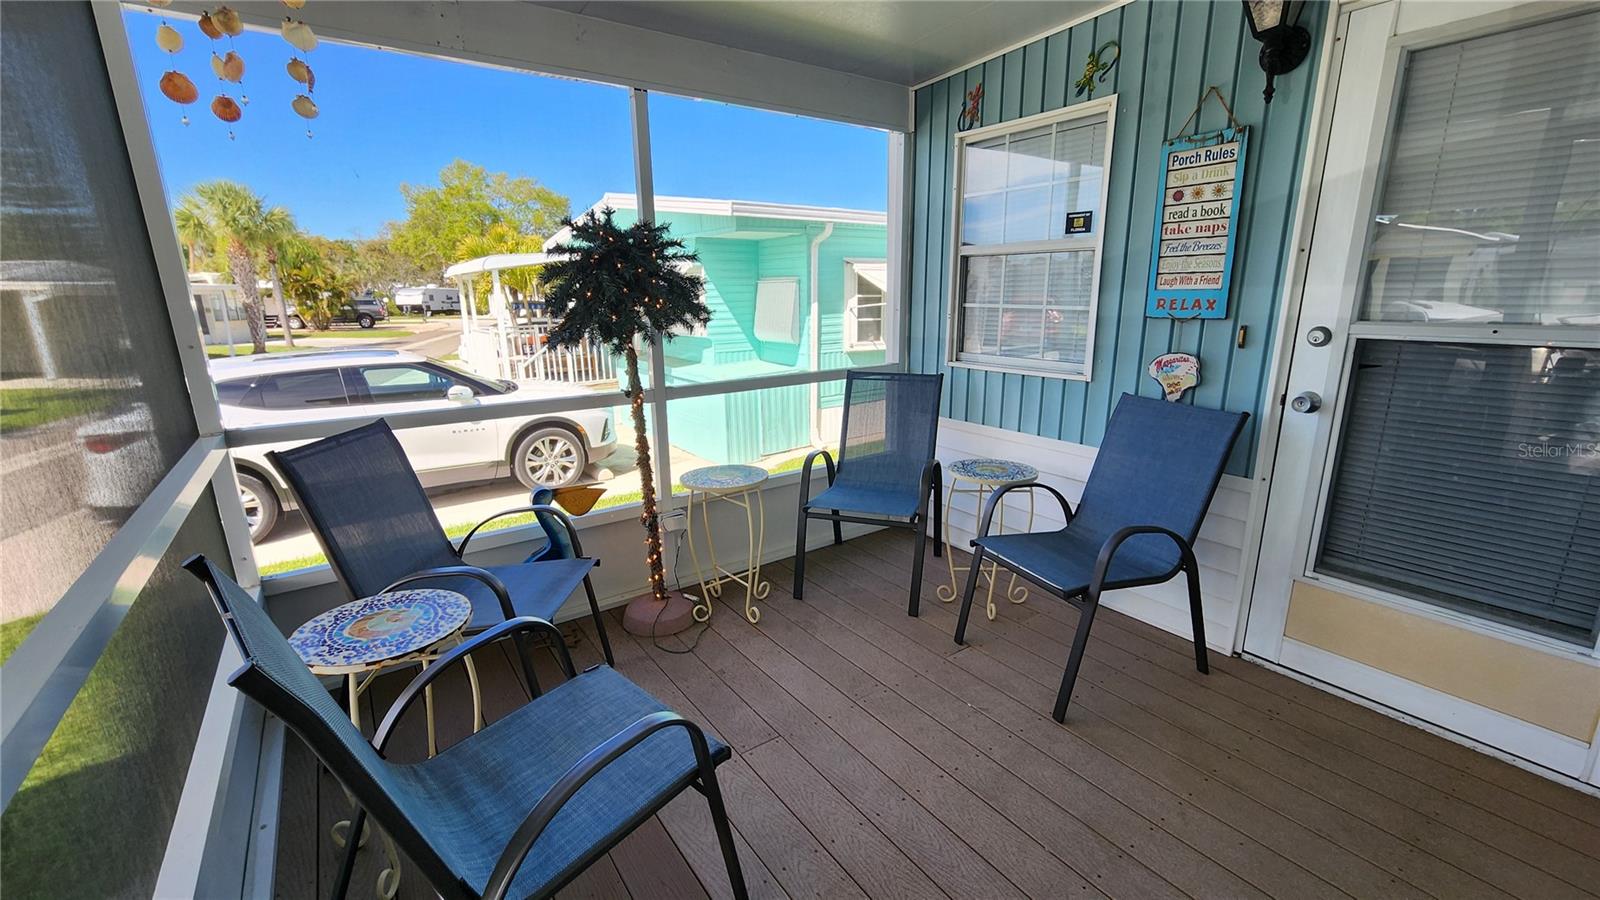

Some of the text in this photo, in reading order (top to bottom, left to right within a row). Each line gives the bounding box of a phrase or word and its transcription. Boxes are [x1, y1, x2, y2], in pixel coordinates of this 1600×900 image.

[1172, 148, 1235, 167] Porch Rules
[1173, 165, 1230, 184] Sip a Drink
[1168, 203, 1226, 220] read a book
[1163, 222, 1227, 235] take naps
[1164, 240, 1222, 255] Feel the Breezes
[1159, 276, 1178, 288] Laugh
[1178, 275, 1193, 286] With
[1198, 275, 1221, 286] Friend
[1156, 298, 1217, 310] RELAX
